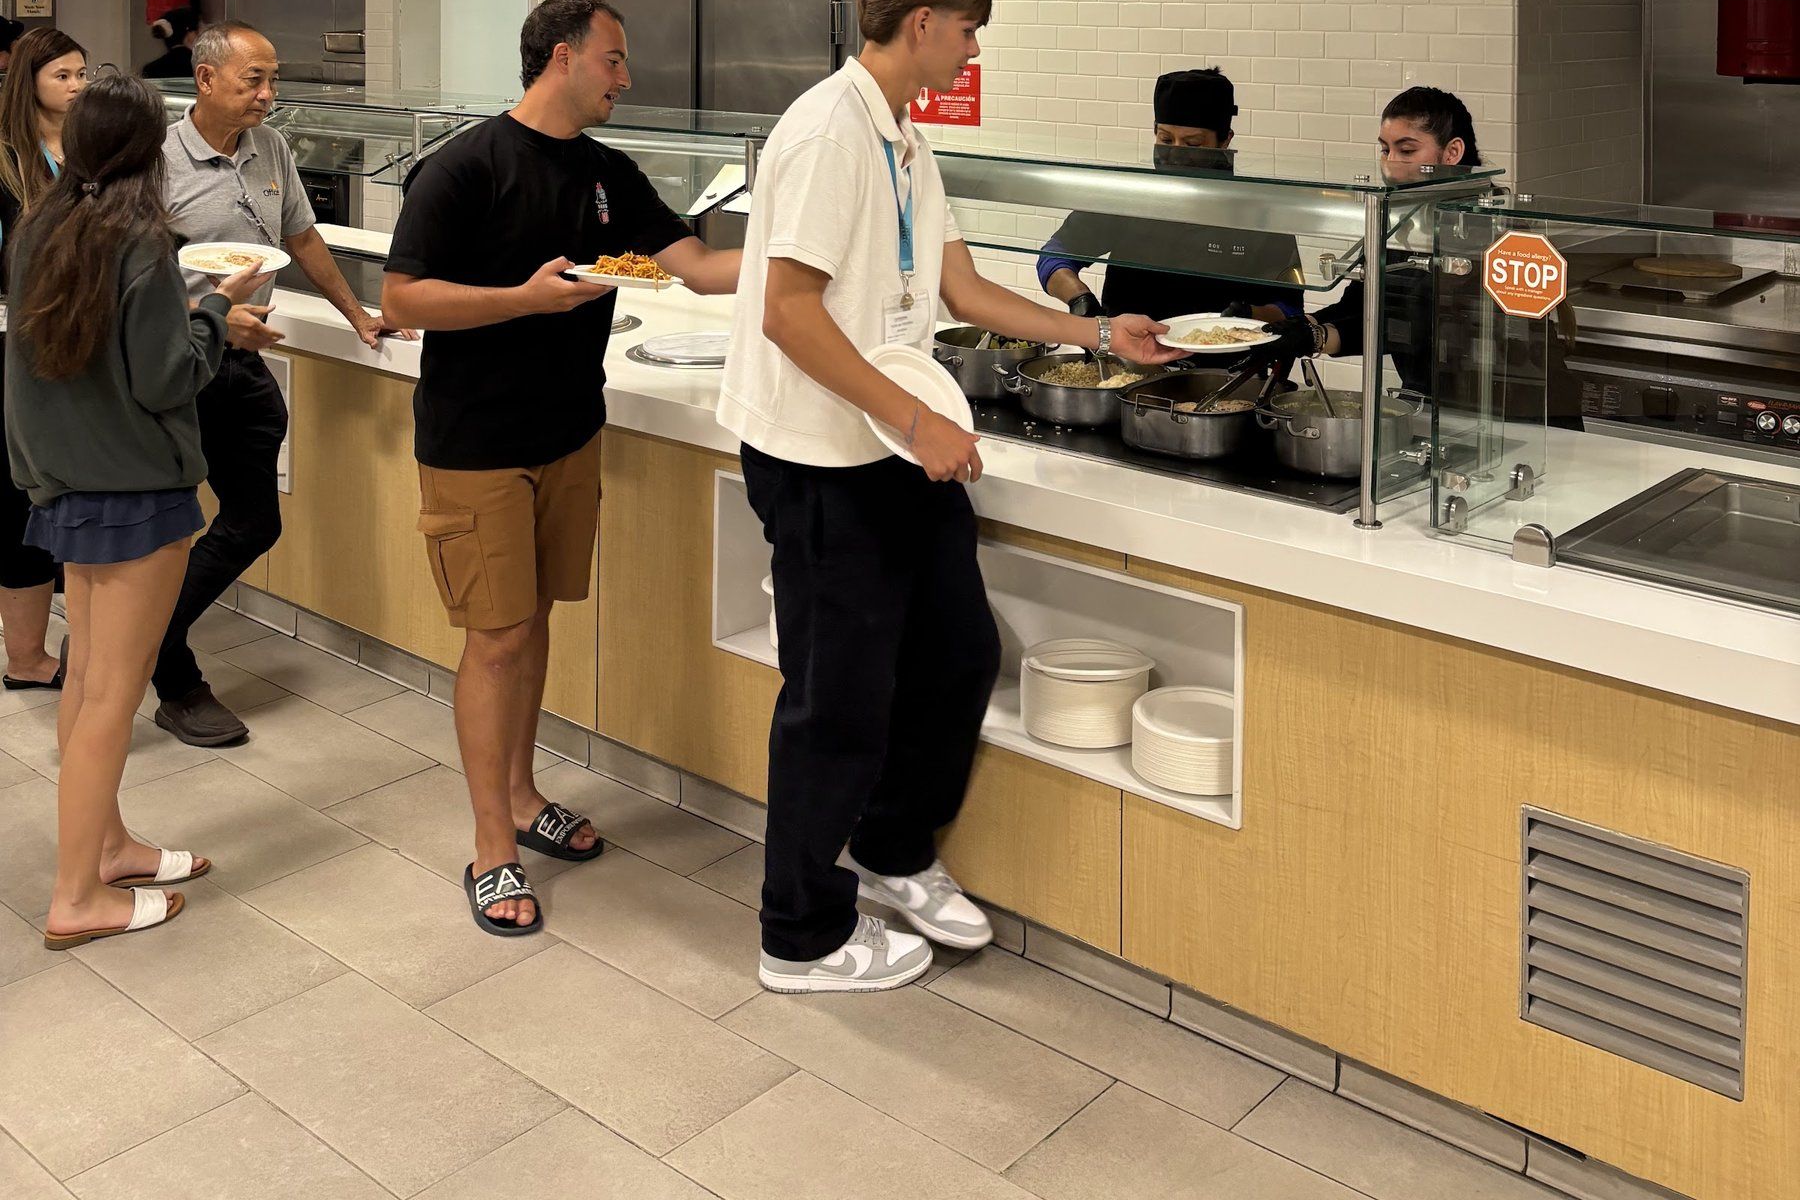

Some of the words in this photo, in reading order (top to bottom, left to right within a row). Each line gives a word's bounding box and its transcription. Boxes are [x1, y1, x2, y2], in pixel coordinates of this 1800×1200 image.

[940, 94, 976, 102] PRECAUCIÓN
[1497, 249, 1511, 257] Have
[1517, 250, 1530, 259] food
[1531, 252, 1552, 262] allergy?
[1491, 257, 1558, 290] STOP
